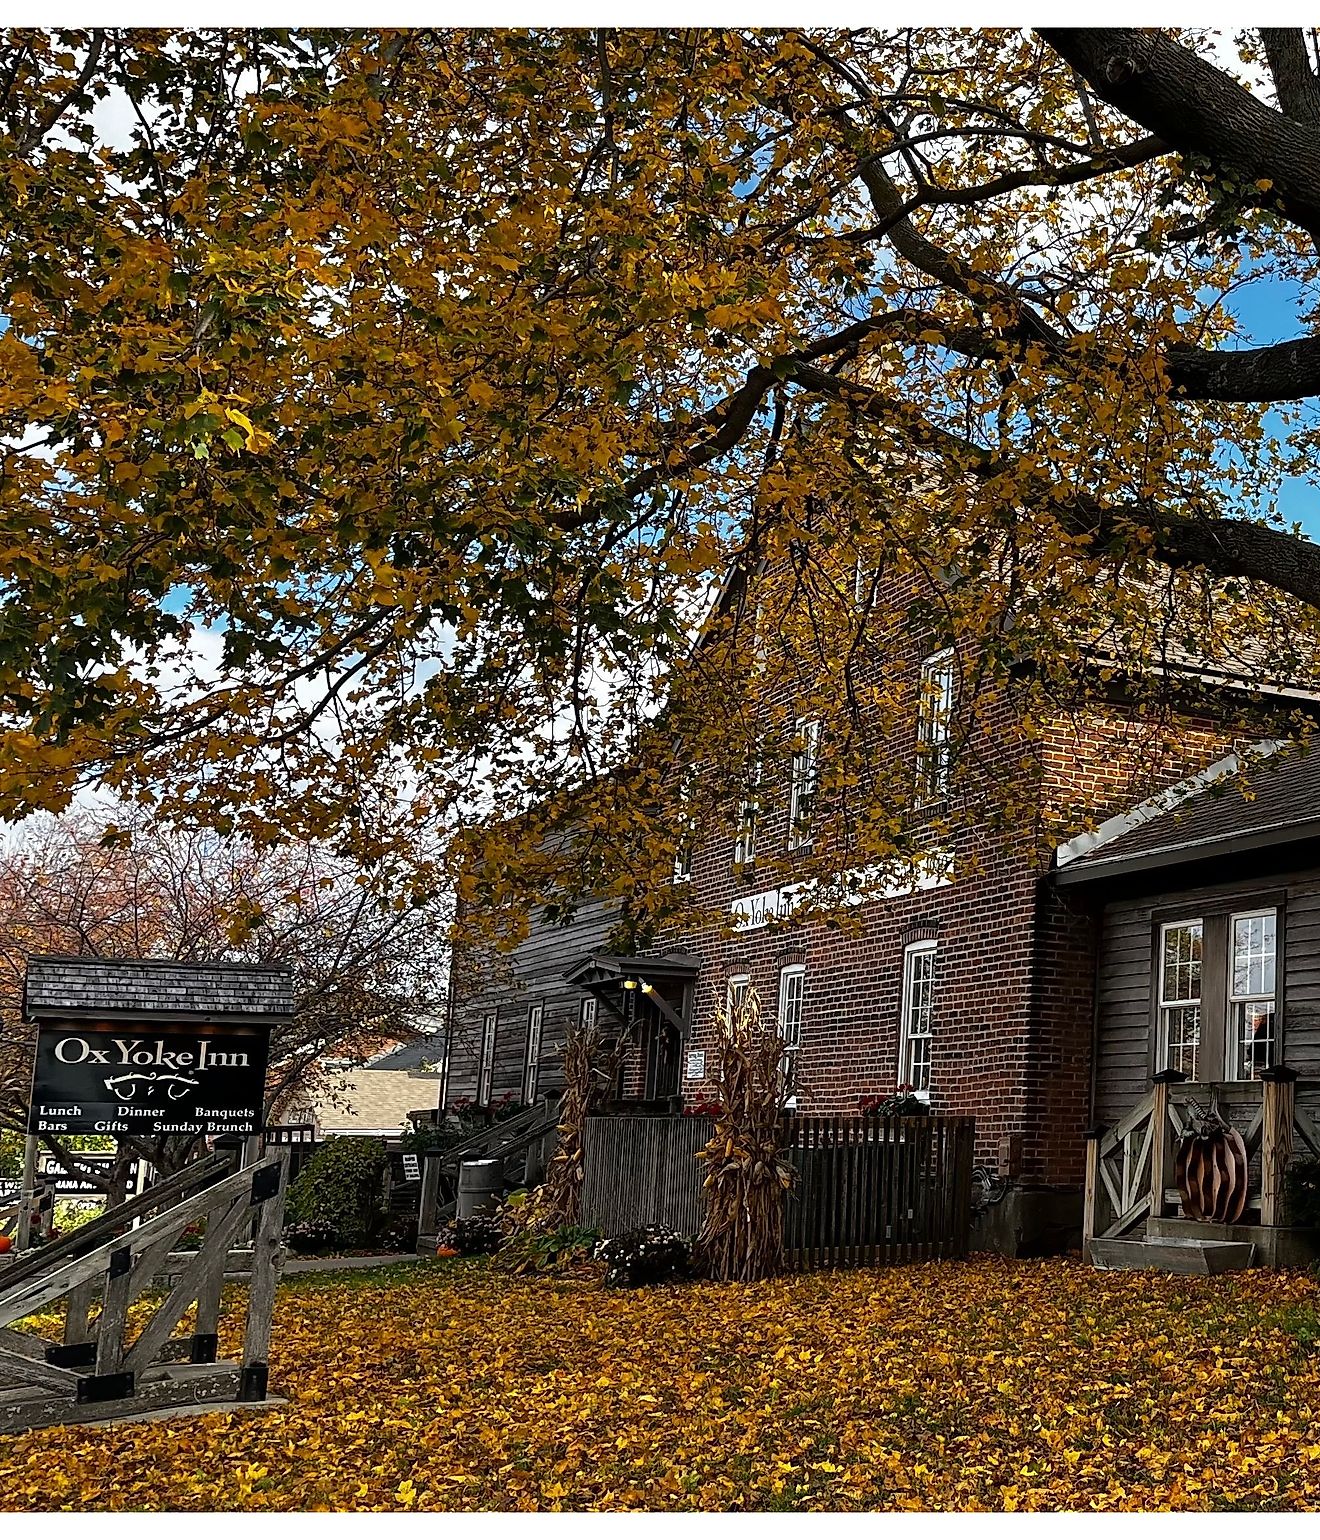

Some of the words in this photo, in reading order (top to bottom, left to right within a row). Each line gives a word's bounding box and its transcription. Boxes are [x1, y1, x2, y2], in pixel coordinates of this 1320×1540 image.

[54, 1037, 111, 1065] Ox
[111, 1039, 194, 1070] Yoke
[194, 1040, 250, 1071] Inn
[39, 1105, 82, 1116] Lunch
[117, 1106, 166, 1117] Dinner
[195, 1107, 255, 1119] Banquets
[38, 1120, 68, 1131] Bars
[94, 1121, 129, 1132] Gifts
[153, 1121, 203, 1134] Sunday
[207, 1121, 253, 1132] Brunch
